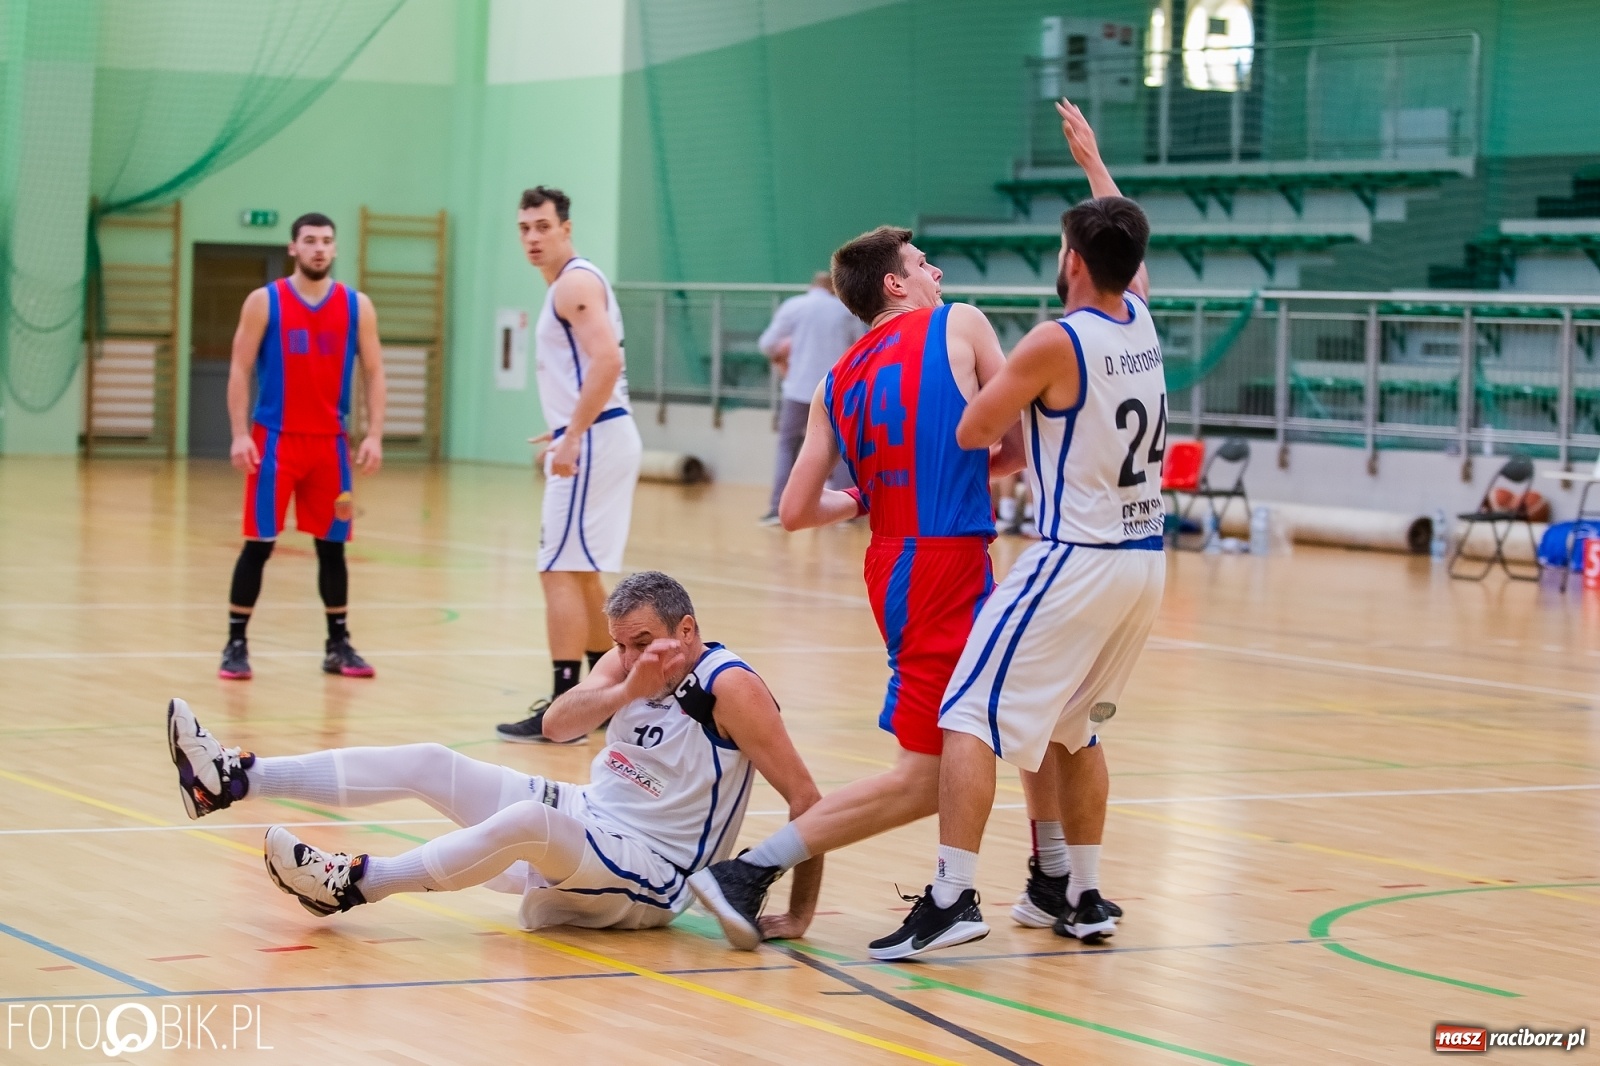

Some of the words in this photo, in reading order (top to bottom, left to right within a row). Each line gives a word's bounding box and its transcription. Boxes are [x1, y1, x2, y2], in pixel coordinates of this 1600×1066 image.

[1105, 355, 1119, 376] D.
[842, 363, 907, 461] 24
[1115, 393, 1167, 487] 24
[675, 673, 697, 698] C
[633, 724, 663, 750] 12
